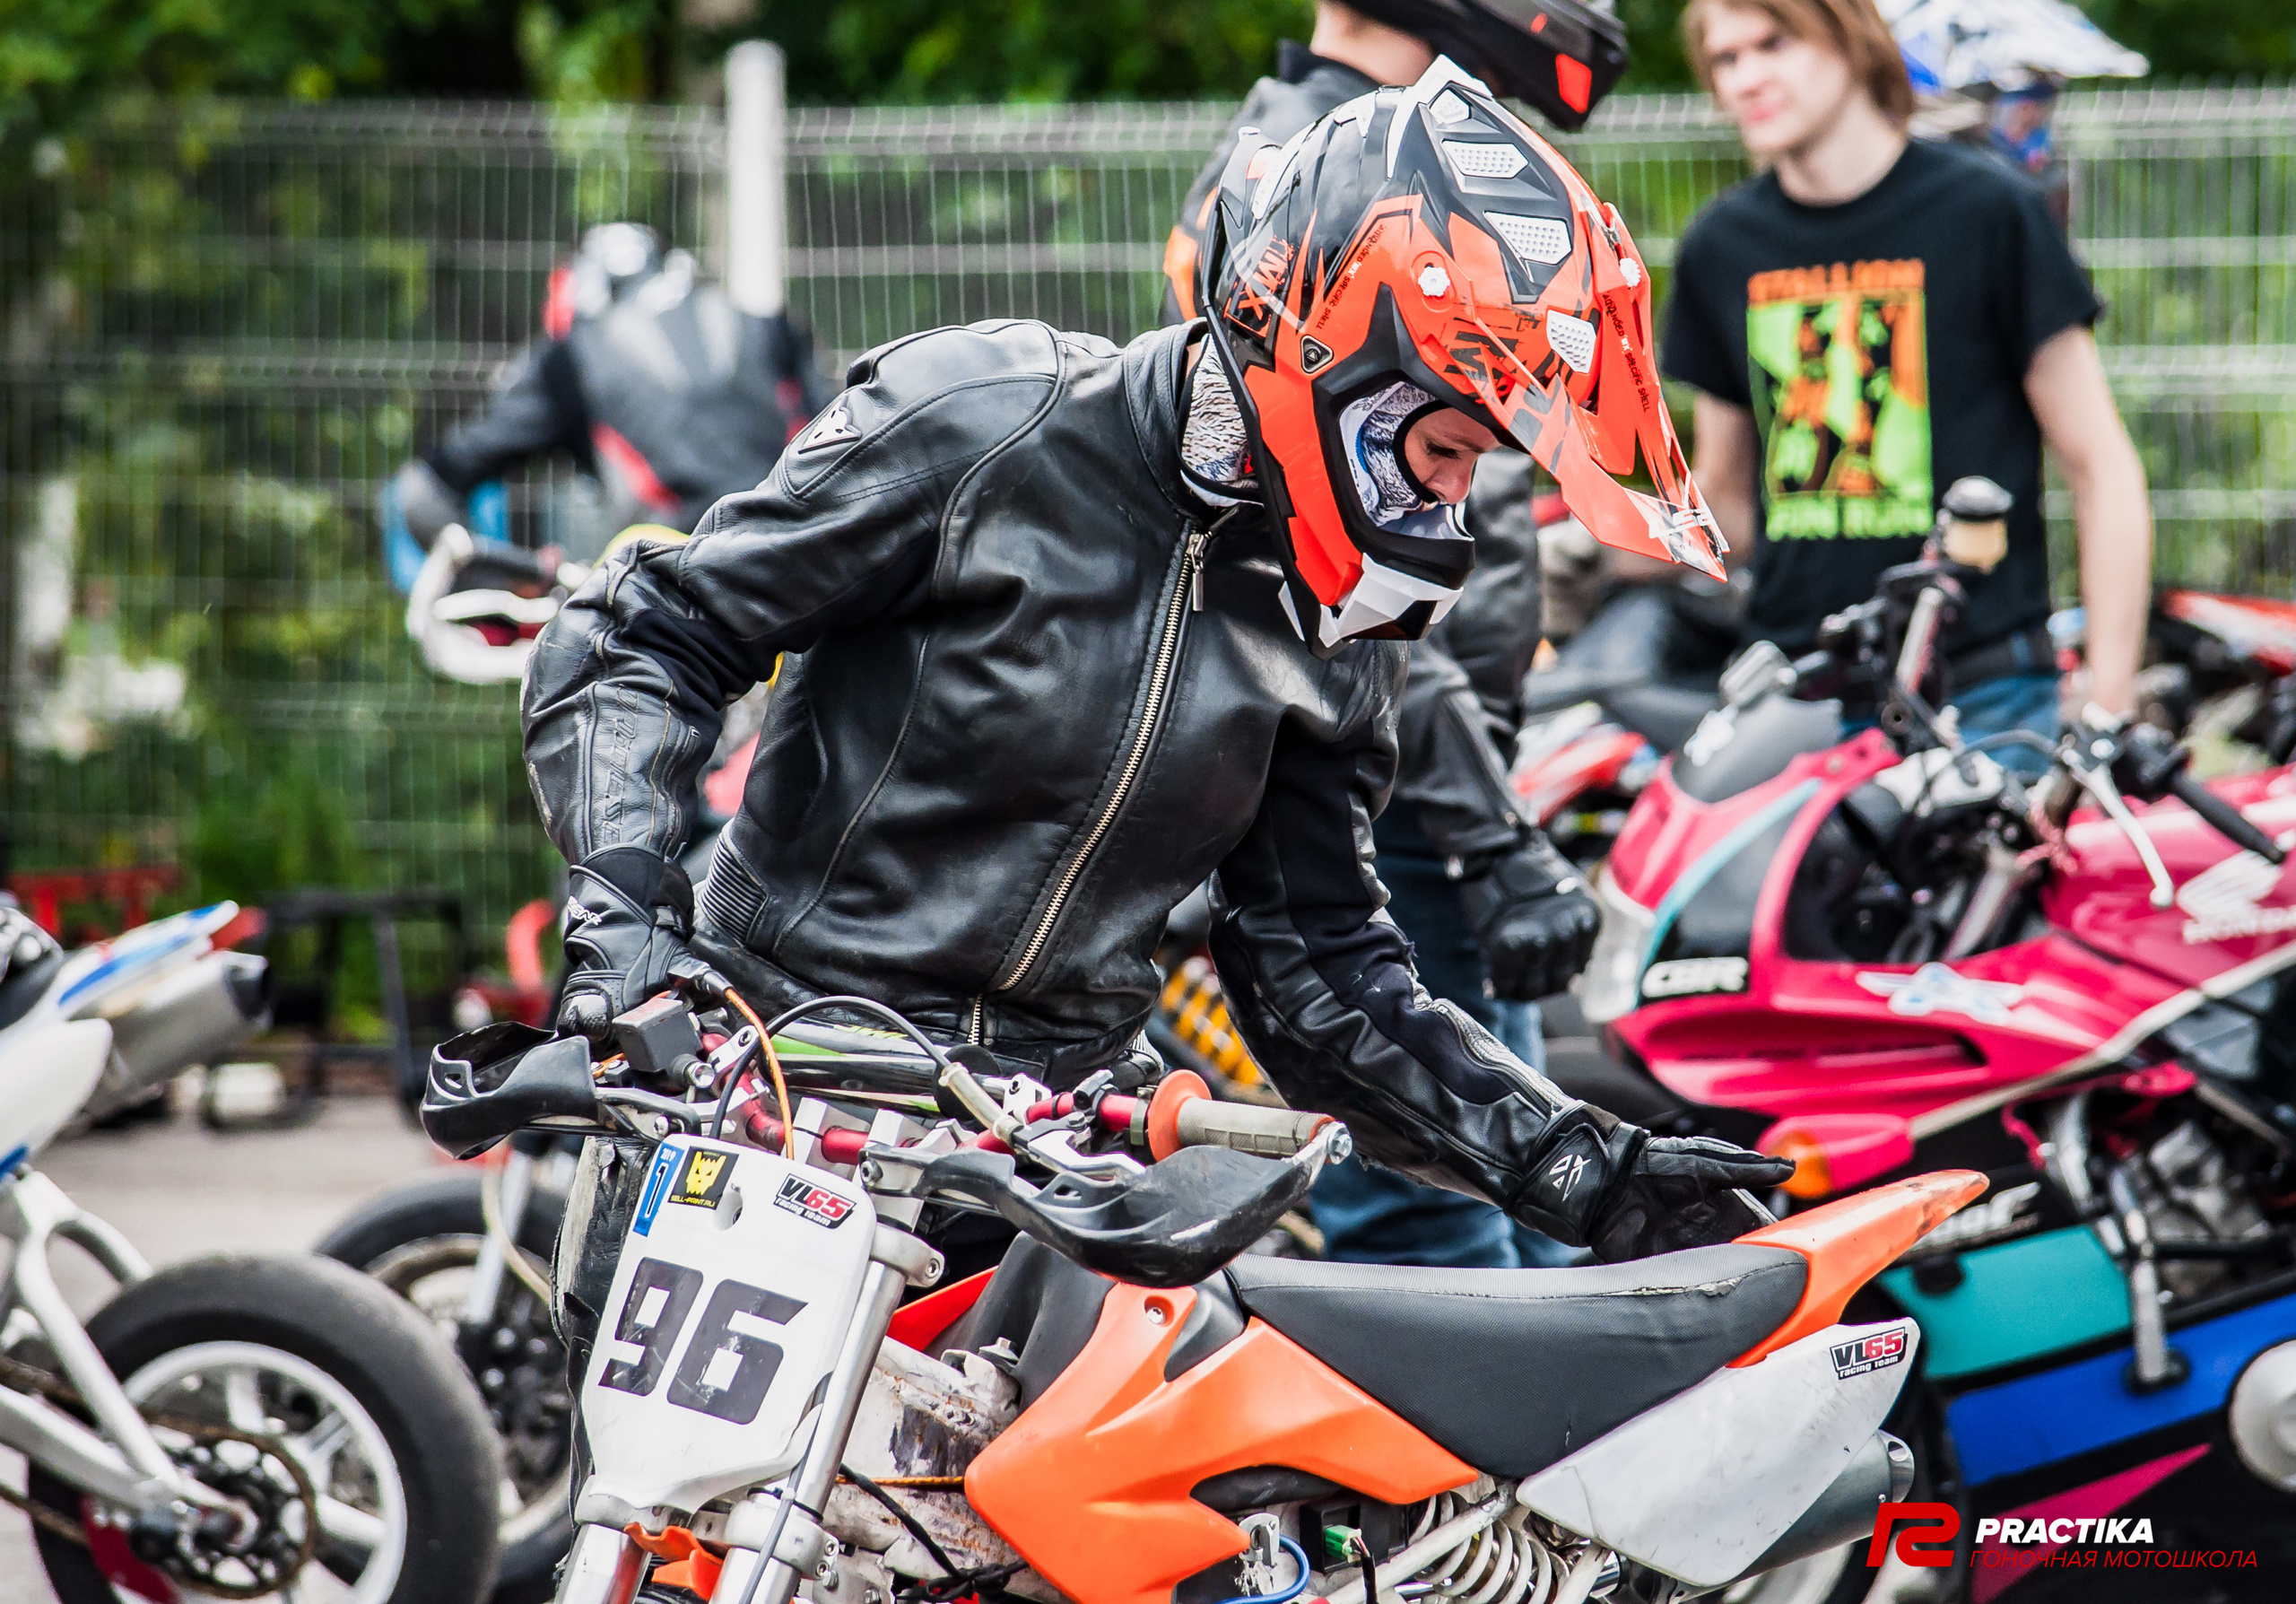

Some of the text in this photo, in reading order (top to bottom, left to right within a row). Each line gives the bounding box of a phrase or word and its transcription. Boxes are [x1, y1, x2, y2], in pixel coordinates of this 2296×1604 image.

[1602, 294, 1624, 336] ADVANCED
[1625, 352, 1642, 385] SPECIFIC
[1638, 388, 1649, 412] SHELL
[775, 1198, 831, 1226] racing team
[781, 1177, 851, 1218] VL65
[598, 1257, 809, 1425] 96
[1834, 1331, 1903, 1368] VL65
[1839, 1356, 1899, 1378] racing team
